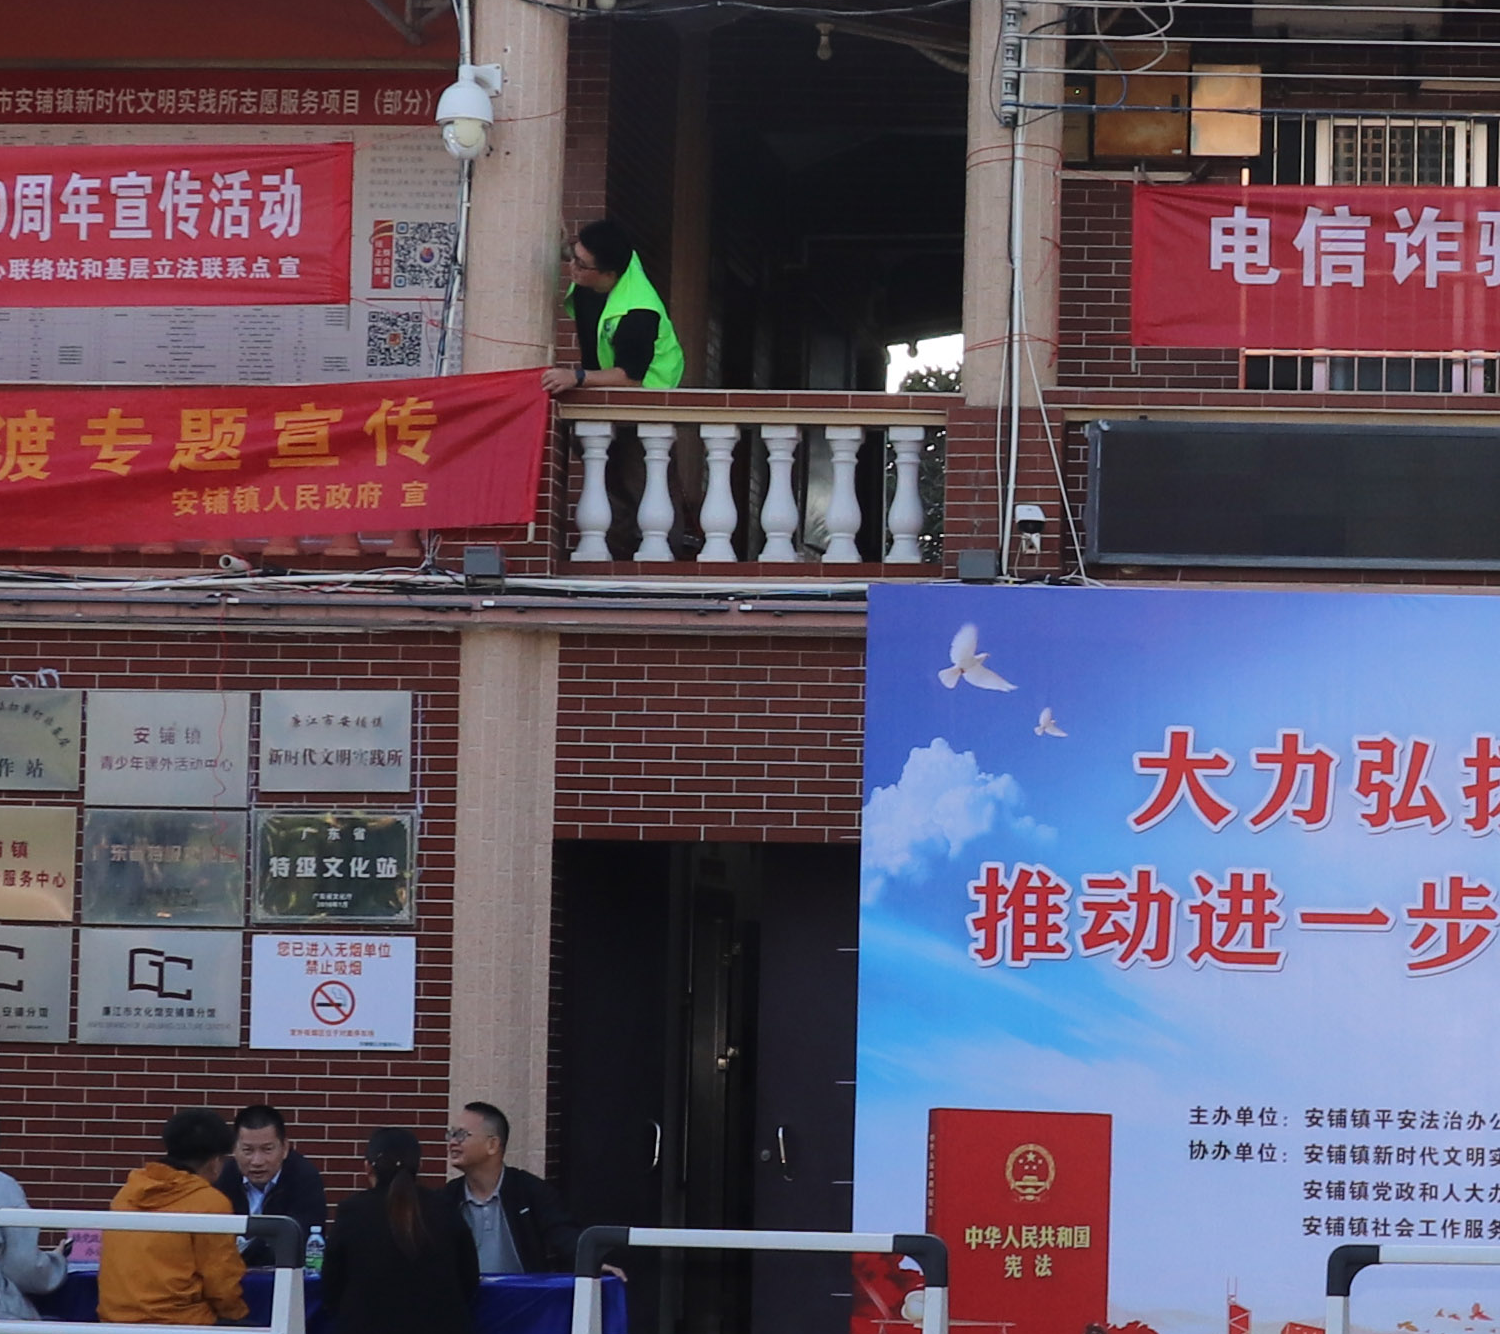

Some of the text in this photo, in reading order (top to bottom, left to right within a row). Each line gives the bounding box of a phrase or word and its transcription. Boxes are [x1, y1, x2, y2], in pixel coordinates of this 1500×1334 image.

[278, 256, 302, 280] 宣
[171, 482, 429, 519] 安铺镇人民政府 宣
[132, 725, 202, 746] 安铺镇
[267, 746, 404, 768] 新时代文明实践所
[300, 826, 367, 842] 广东省
[269, 856, 398, 879] 特级文化站
[276, 940, 393, 959] 您已进入无烟单位
[304, 960, 363, 977] 禁止吸烟
[964, 1225, 1091, 1250] 中华人民共和国
[1003, 1254, 1053, 1279] 宪法
